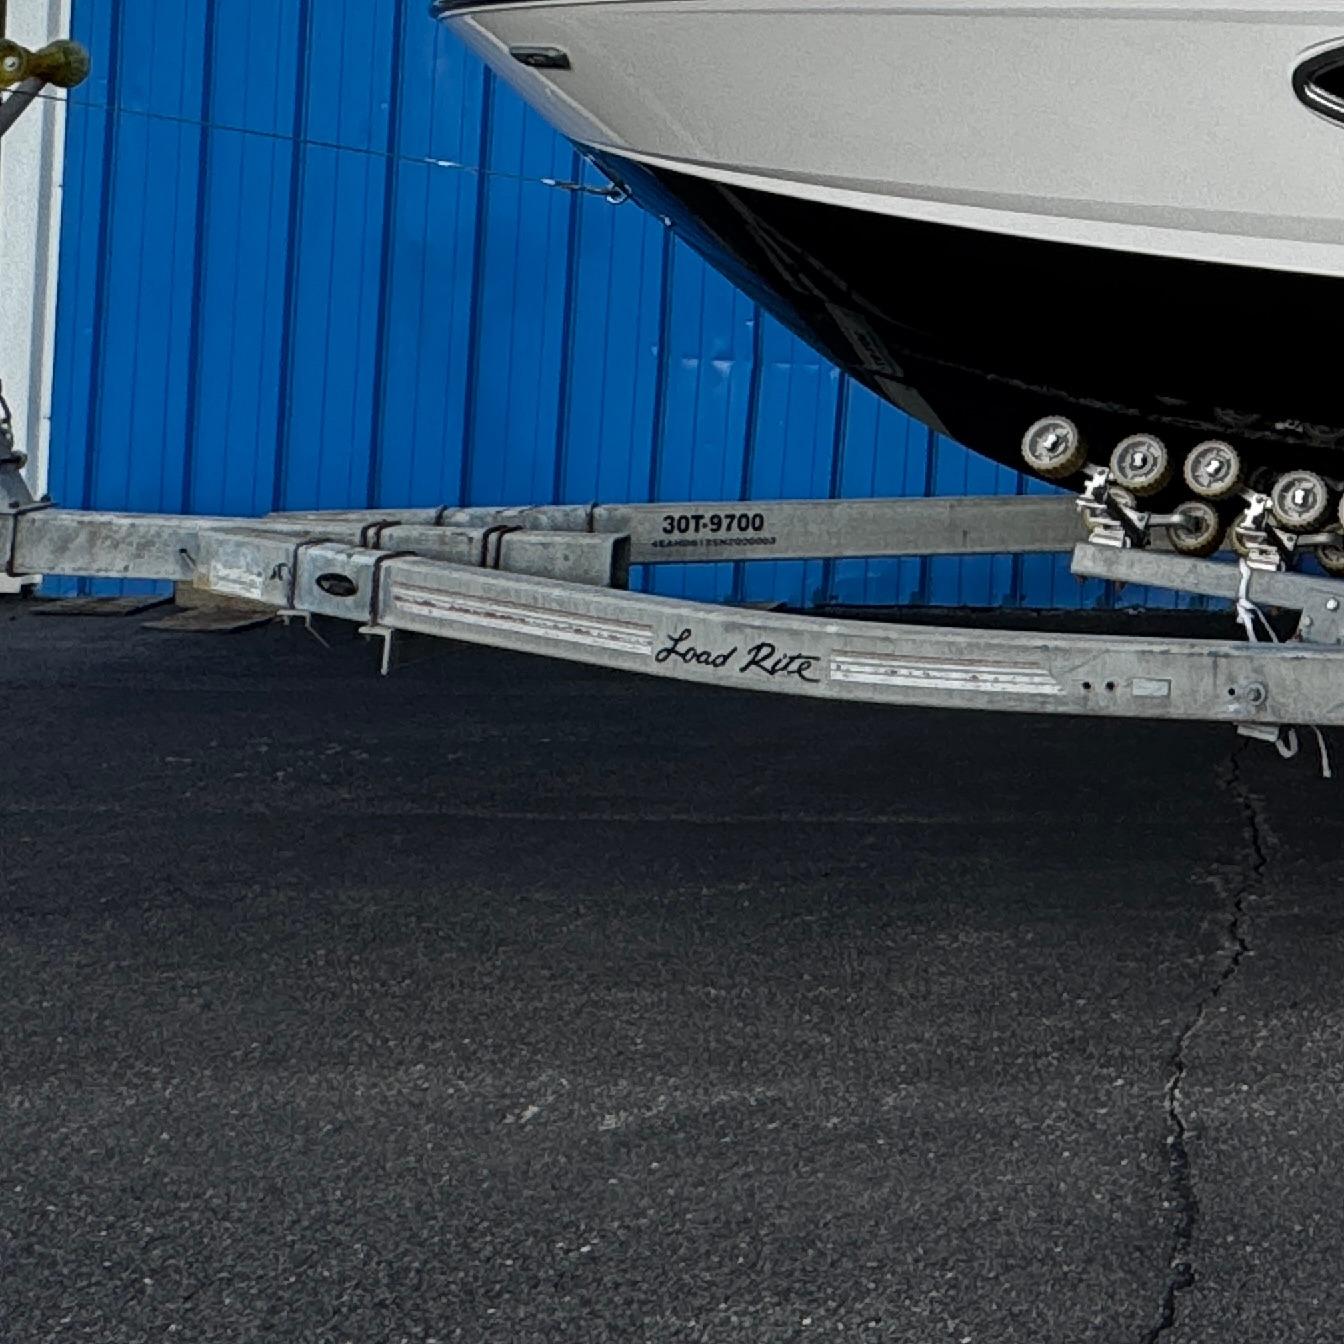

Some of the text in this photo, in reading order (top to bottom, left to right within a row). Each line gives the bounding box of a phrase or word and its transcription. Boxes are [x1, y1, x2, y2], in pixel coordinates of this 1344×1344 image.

[662, 512, 765, 534] 30T-9700
[655, 628, 821, 683] Load Rite
